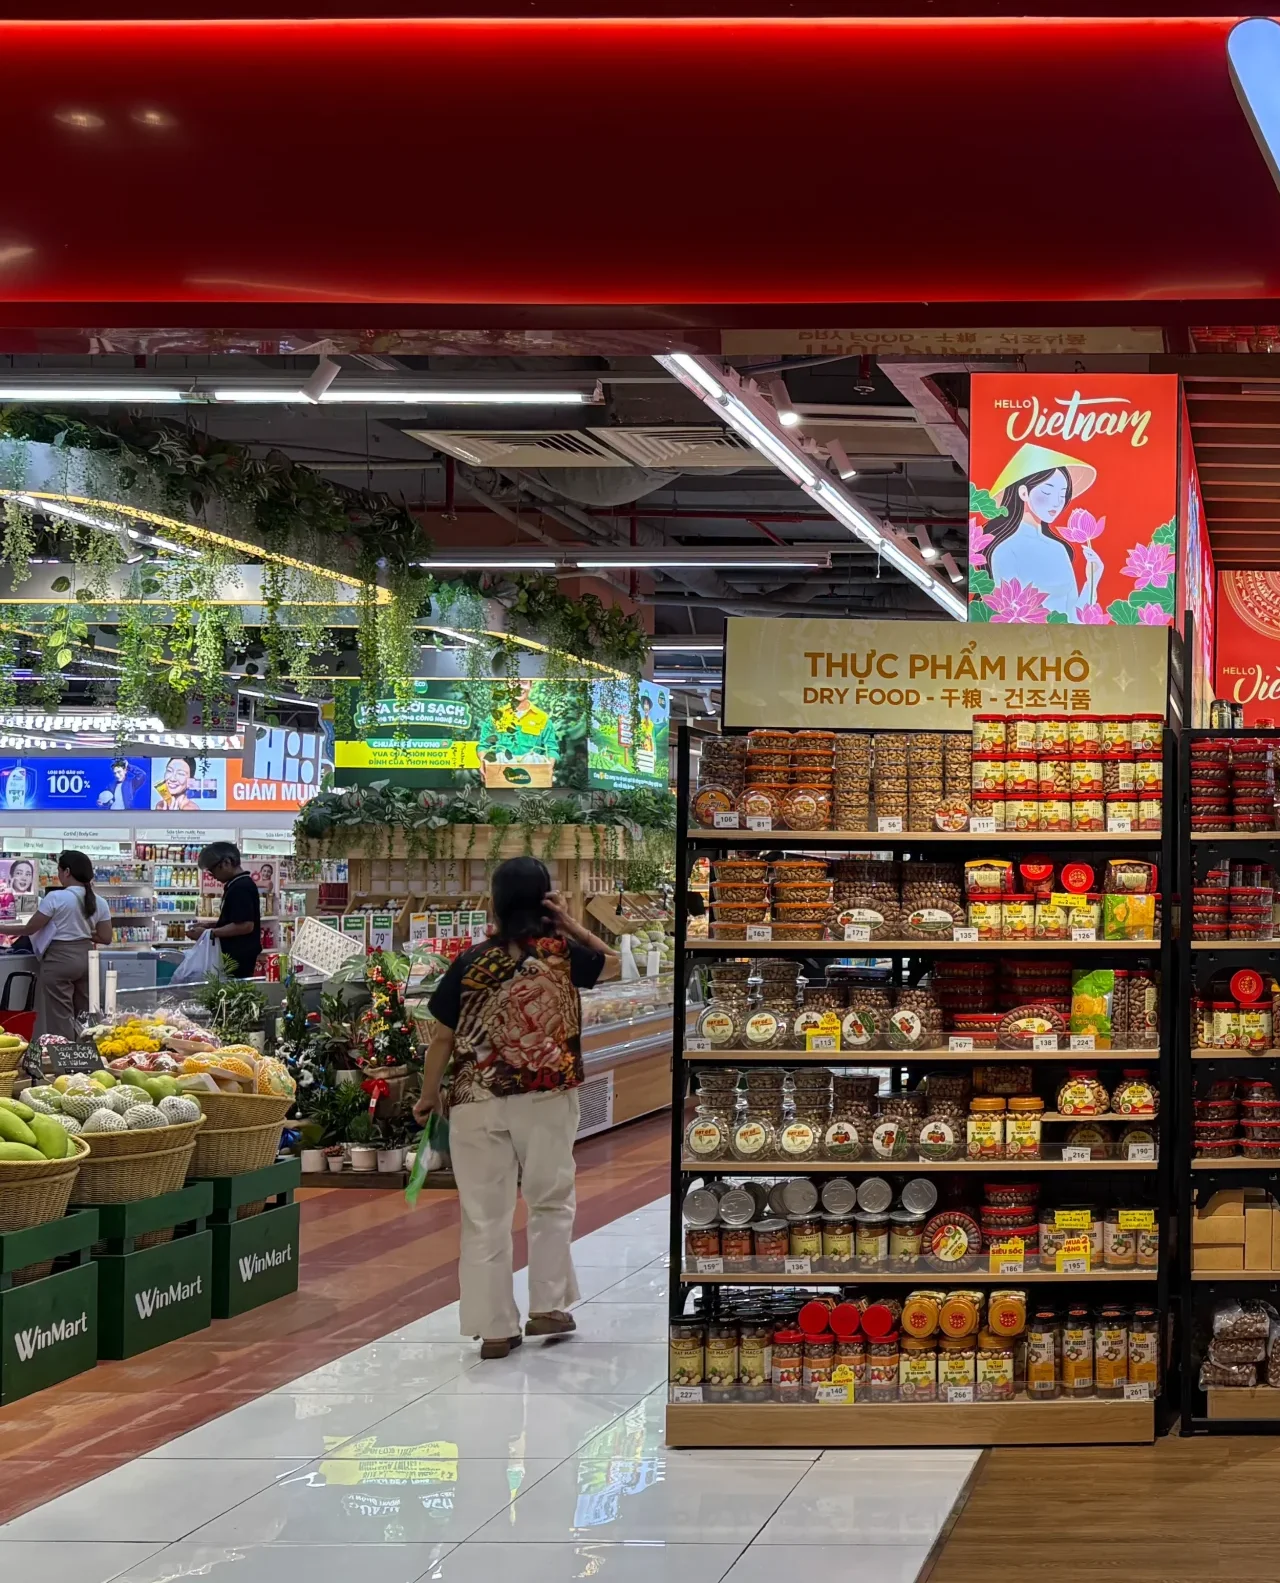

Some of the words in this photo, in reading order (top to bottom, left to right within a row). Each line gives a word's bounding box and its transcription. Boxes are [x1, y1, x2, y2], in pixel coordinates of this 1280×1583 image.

[994, 399, 1032, 409] HELLO
[1006, 390, 1152, 447] Vietnam
[804, 649, 899, 684] THỰC
[909, 640, 1006, 681] PHẨM
[1017, 650, 1090, 682] KHÔ
[1222, 667, 1255, 675] HELLO
[428, 703, 466, 716] SẠCH
[803, 687, 850, 705] DRY
[855, 687, 921, 706] FOOD
[940, 688, 983, 709] 干粮
[1004, 687, 1092, 711] 건조식품
[47, 775, 91, 793] 100%
[233, 779, 277, 801] GIẢM
[1081, 1236, 1088, 1244] 2
[239, 1243, 292, 1283] WinMart
[135, 1276, 202, 1320] WinMart
[14, 1311, 89, 1362] WinMart
